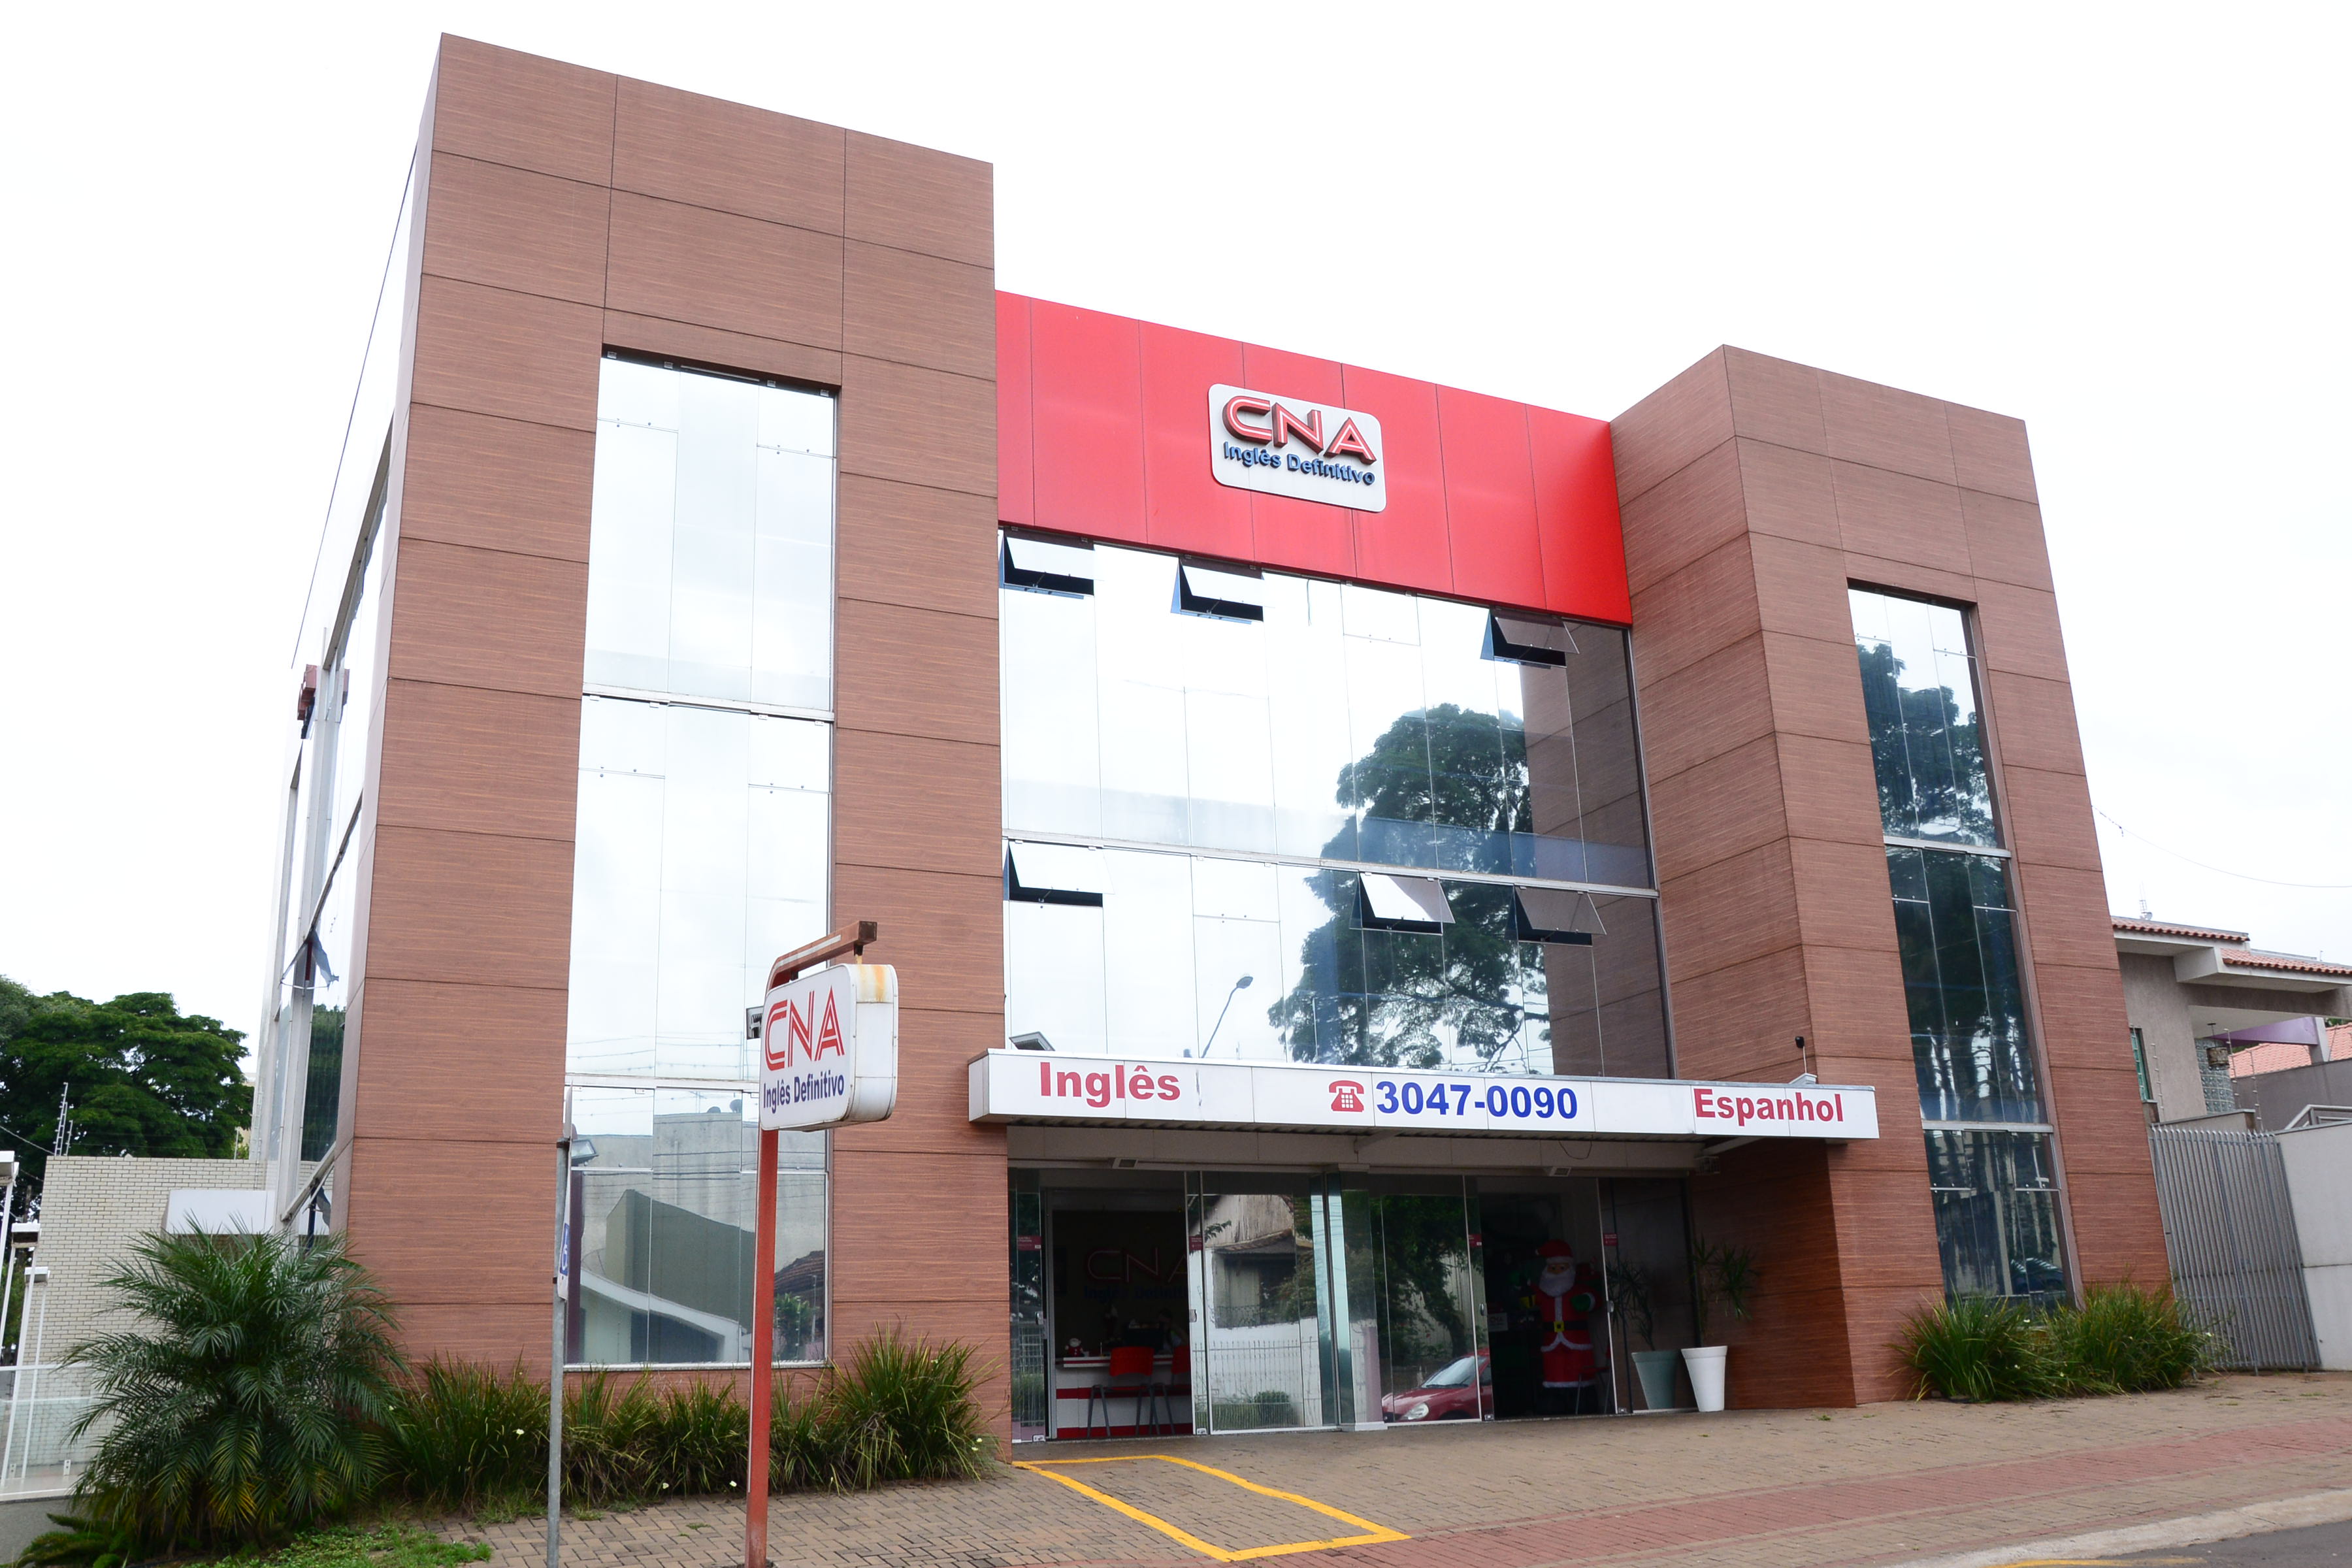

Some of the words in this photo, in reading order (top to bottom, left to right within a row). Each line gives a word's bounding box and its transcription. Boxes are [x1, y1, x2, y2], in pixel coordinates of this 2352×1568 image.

[1222, 396, 1377, 465] CNA
[1223, 442, 1282, 468] Inglês
[1287, 453, 1375, 485] Definitivo
[765, 985, 845, 1071] CNA
[763, 1077, 791, 1114] Inglês
[794, 1070, 844, 1103] Definitivo
[1040, 1062, 1181, 1108] Inglês
[1376, 1081, 1577, 1119] 3047-0090
[1693, 1088, 1844, 1127] Espanhol
